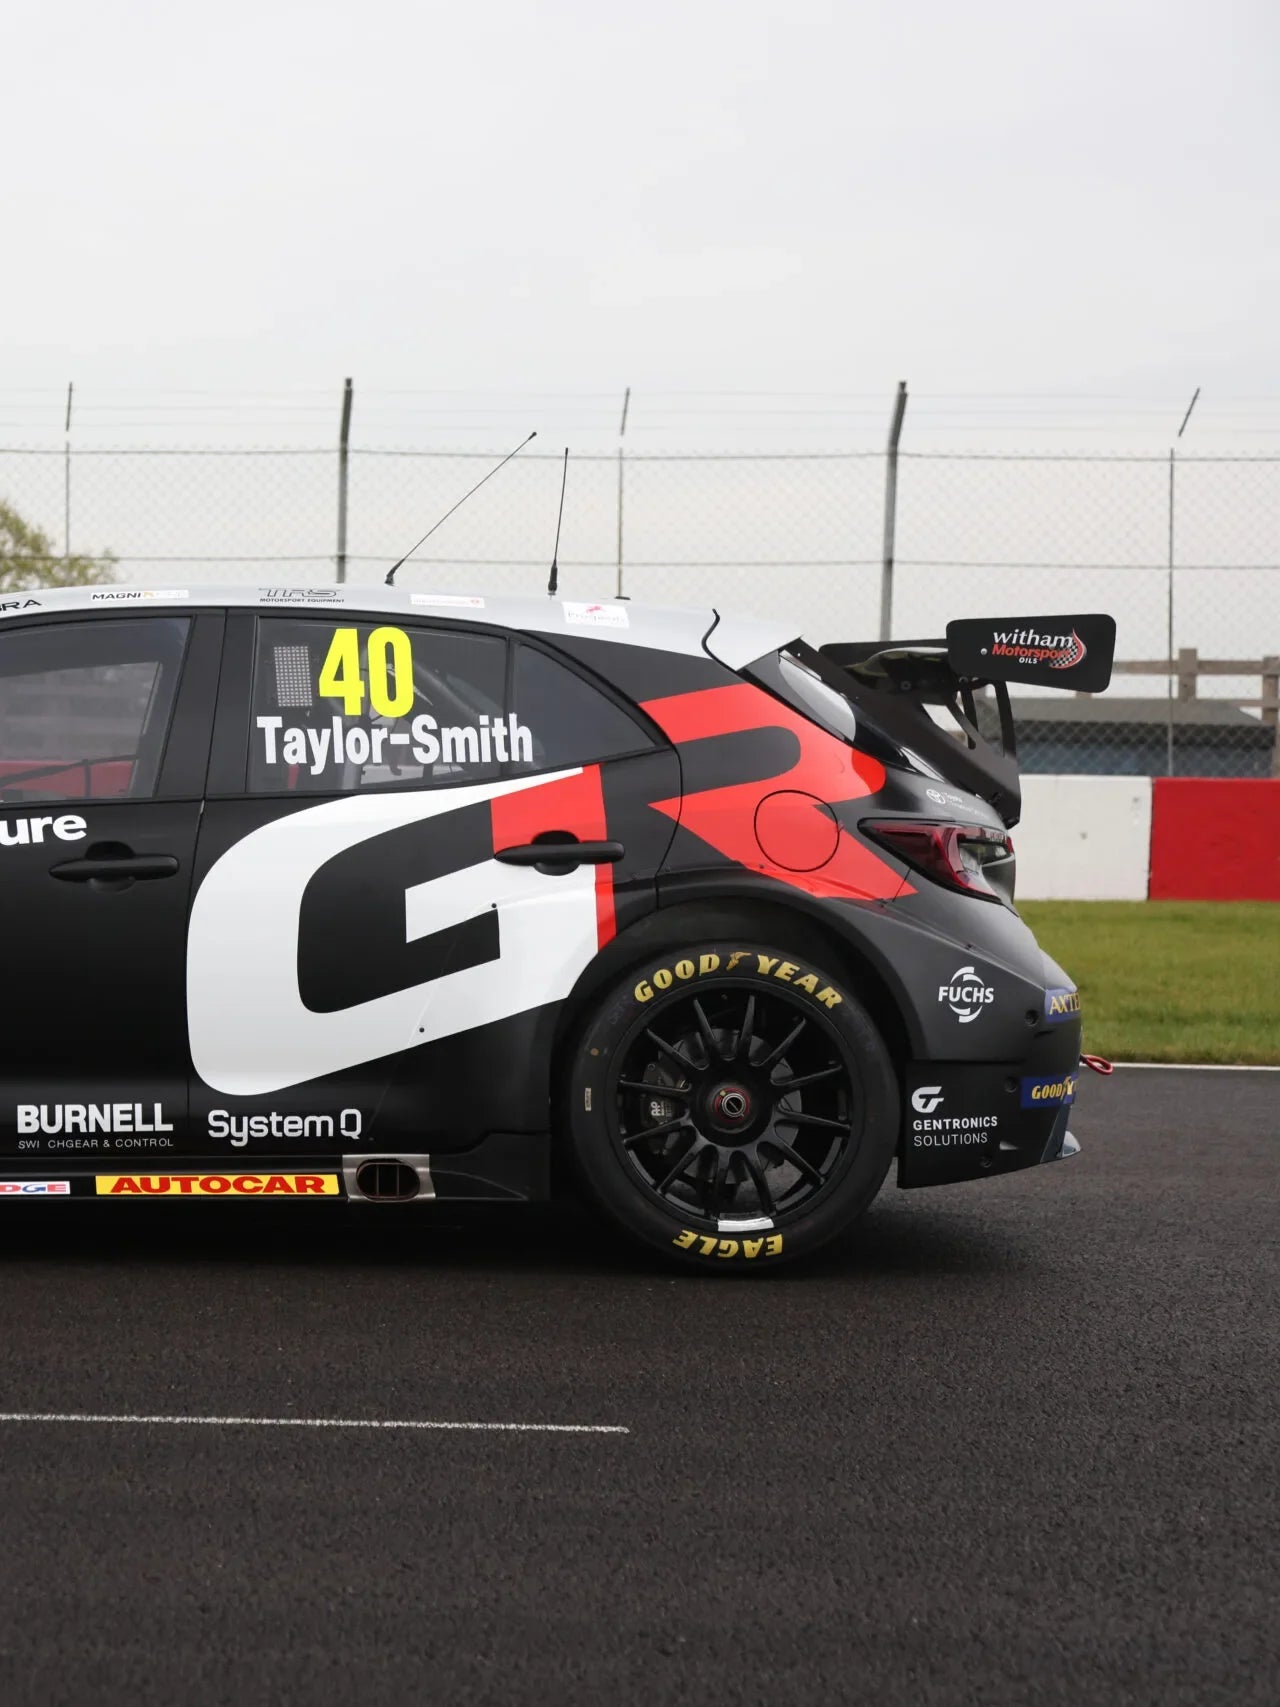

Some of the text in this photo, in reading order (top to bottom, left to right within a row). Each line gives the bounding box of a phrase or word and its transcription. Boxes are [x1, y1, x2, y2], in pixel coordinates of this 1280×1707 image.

[993, 629, 1072, 648] witham
[318, 626, 414, 717] 40
[257, 713, 533, 775] Taylor-Smith
[938, 986, 994, 1003] FUCHS
[1050, 992, 1080, 1015] AXTE
[17, 1103, 174, 1134] BURNELL
[913, 1116, 998, 1130] GENTRONICS
[103, 1139, 110, 1148] &
[115, 1138, 174, 1148] CONTROL
[913, 1132, 988, 1147] SOLUTIONS
[110, 1176, 325, 1194] AUTOCAR
[673, 1229, 783, 1258] EAGLE
